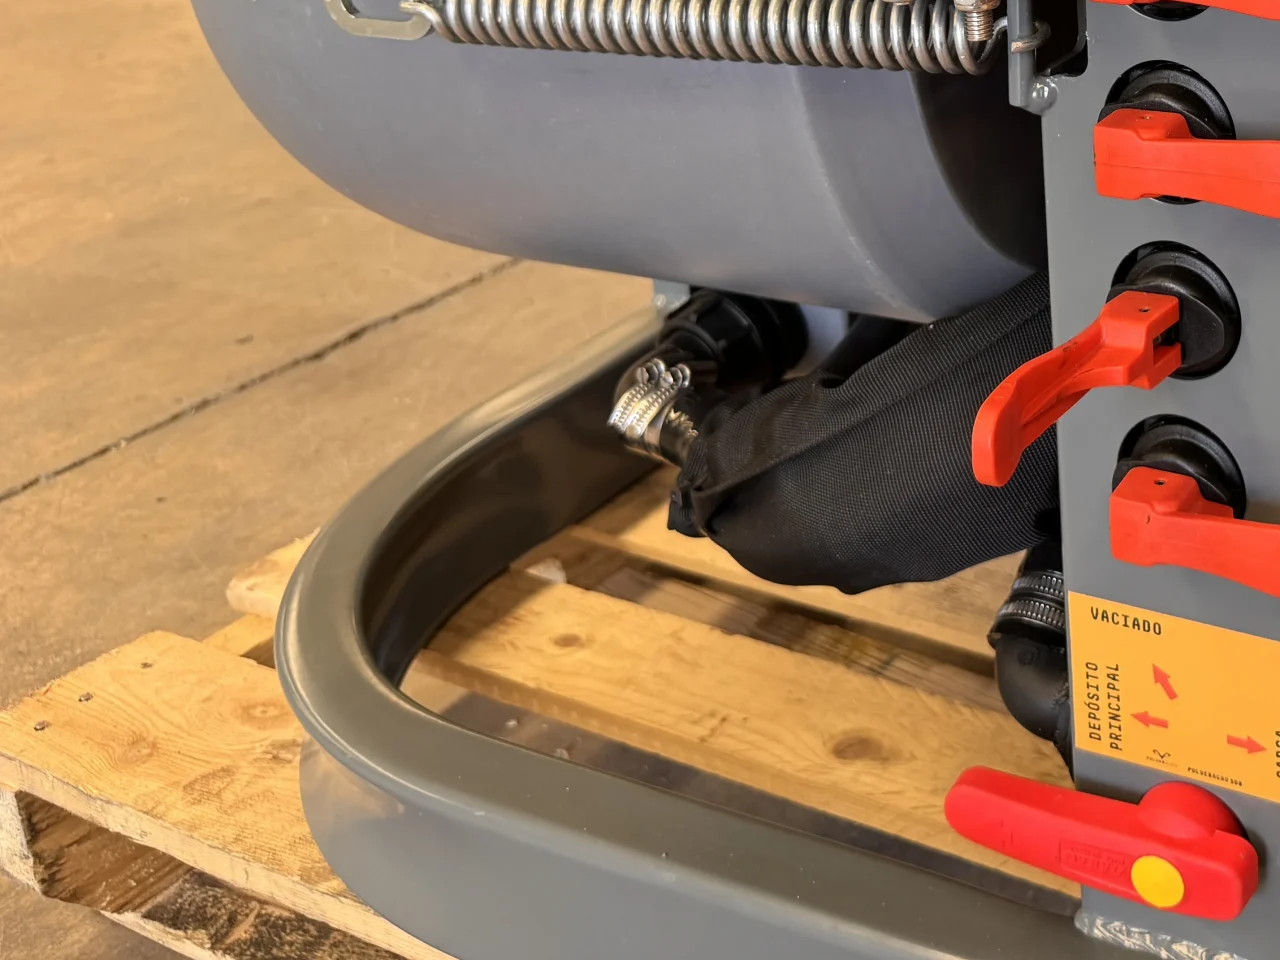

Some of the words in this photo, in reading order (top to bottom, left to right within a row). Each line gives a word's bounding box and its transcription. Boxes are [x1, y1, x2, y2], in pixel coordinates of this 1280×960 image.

[1091, 606, 1162, 636] VACIADO
[1084, 661, 1101, 741] DEPÓSITO
[1106, 663, 1123, 751] PRINCIPAL
